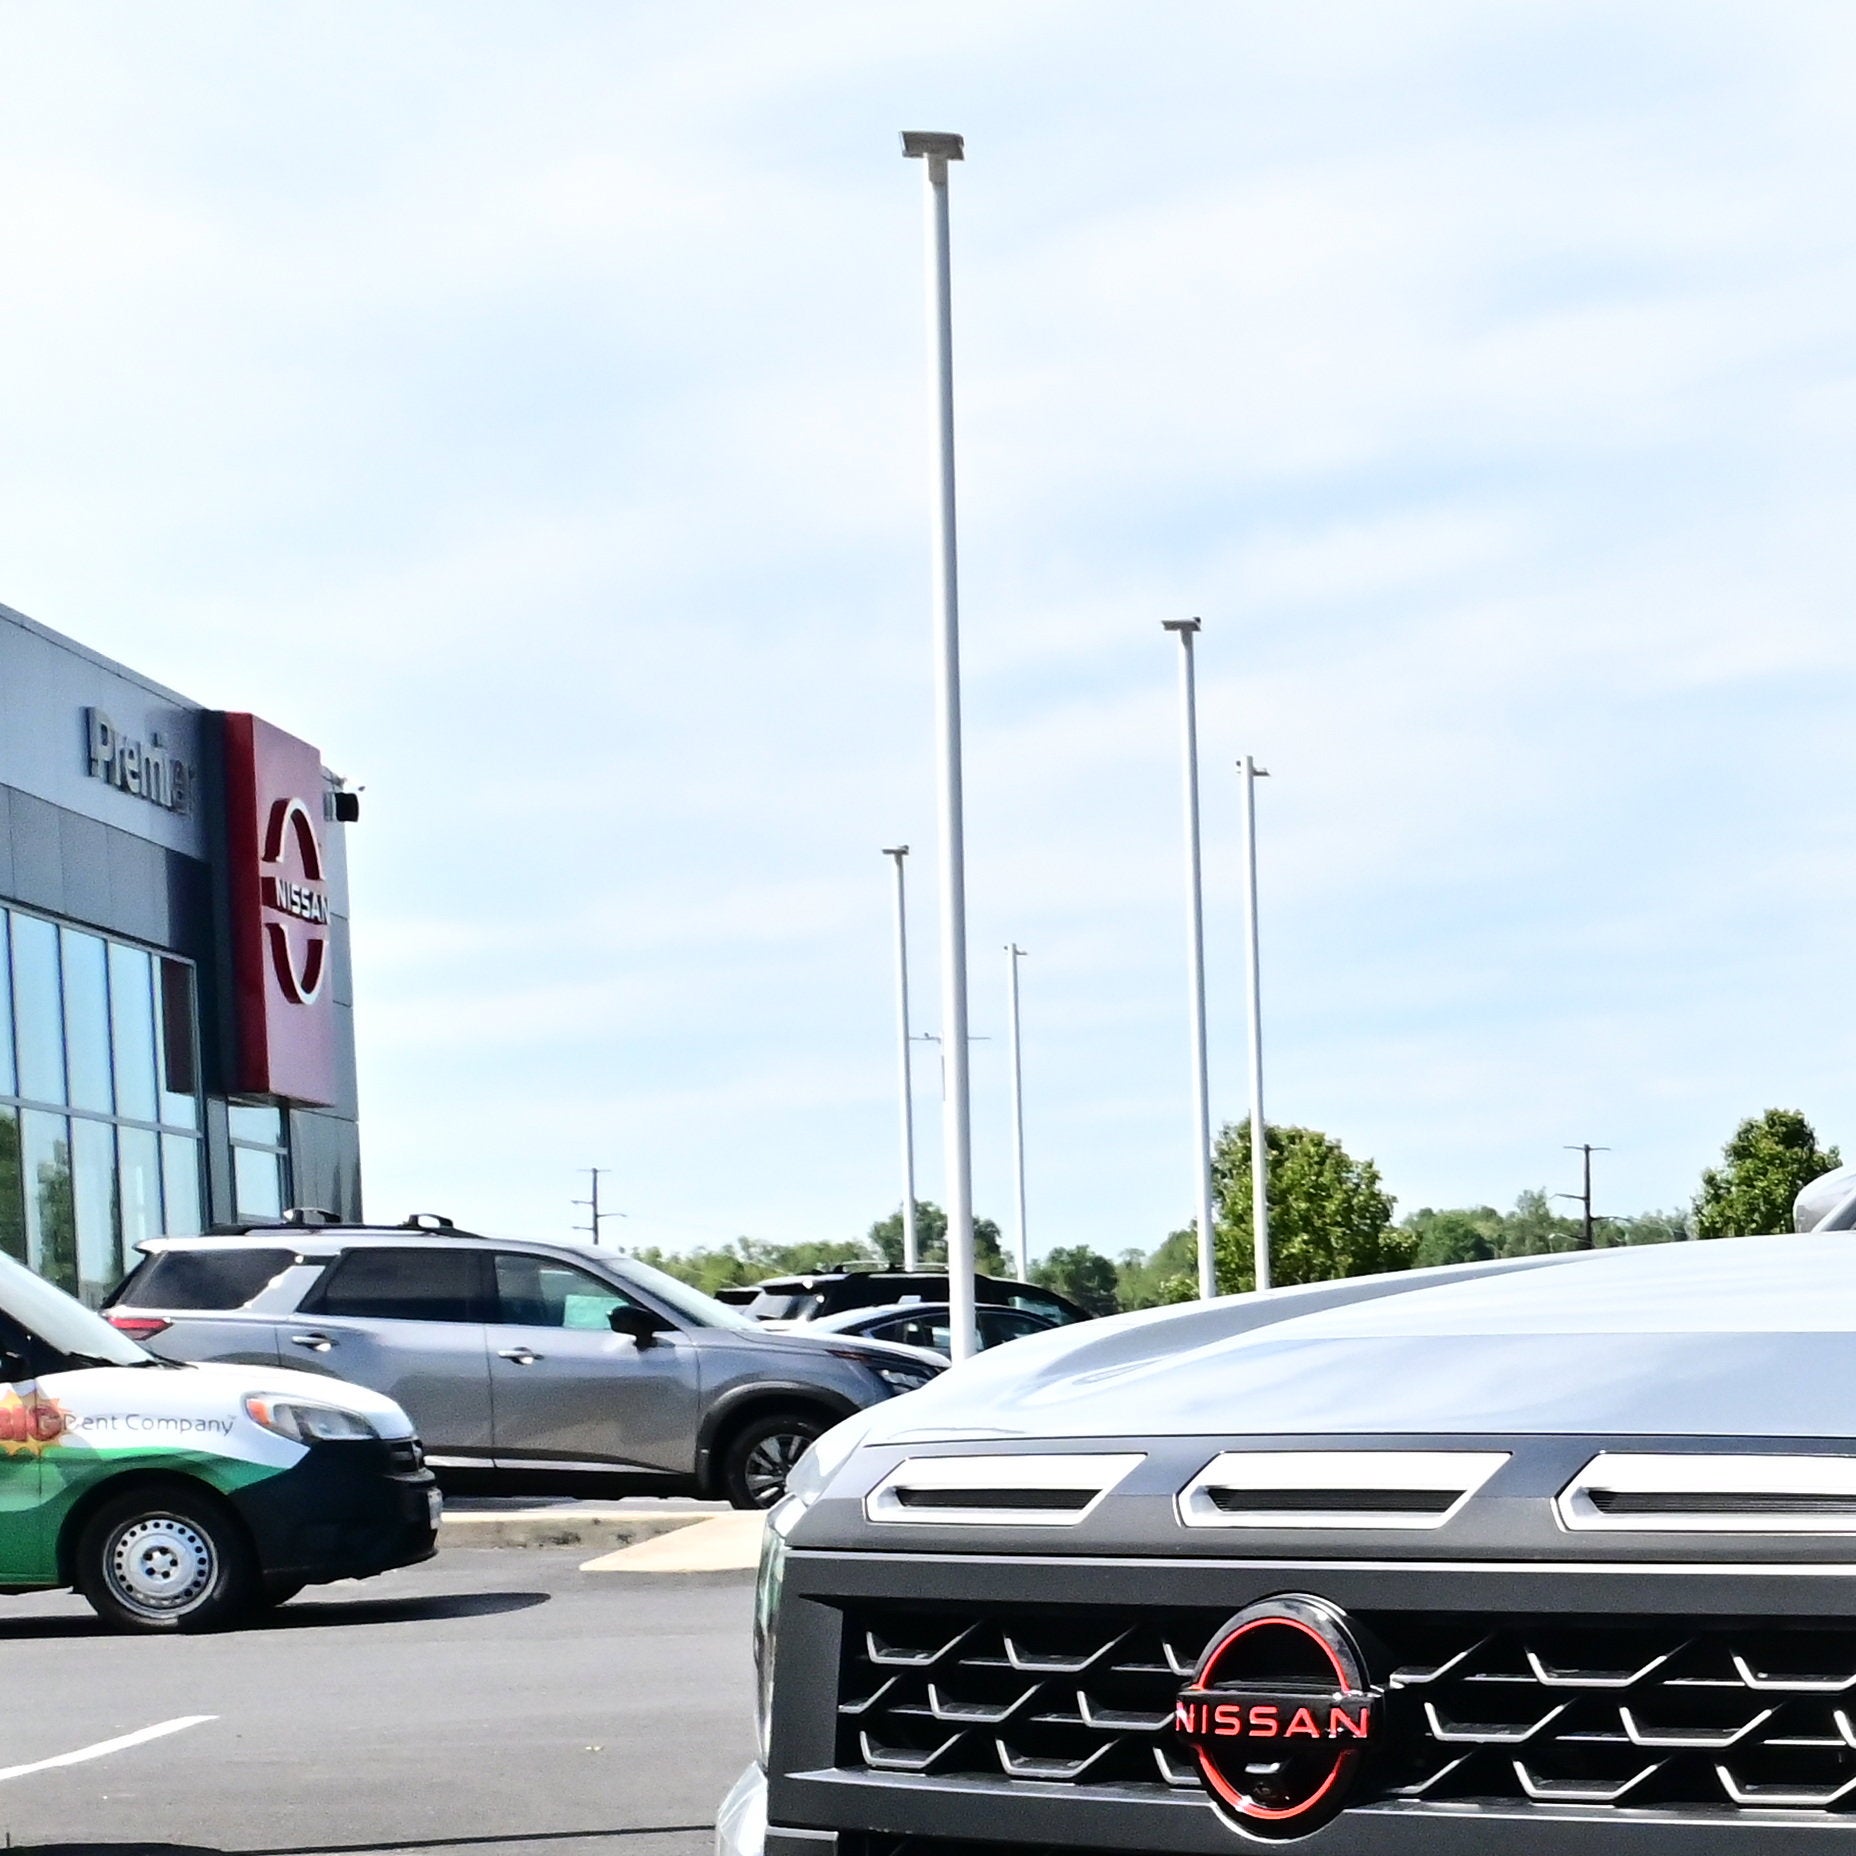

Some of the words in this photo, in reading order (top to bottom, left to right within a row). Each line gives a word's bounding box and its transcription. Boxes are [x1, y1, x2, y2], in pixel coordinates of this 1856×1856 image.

[82, 706, 197, 820] Premier
[276, 876, 331, 924] NISSAN
[126, 1413, 233, 1436] Company
[1176, 1700, 1368, 1738] NISSAN
